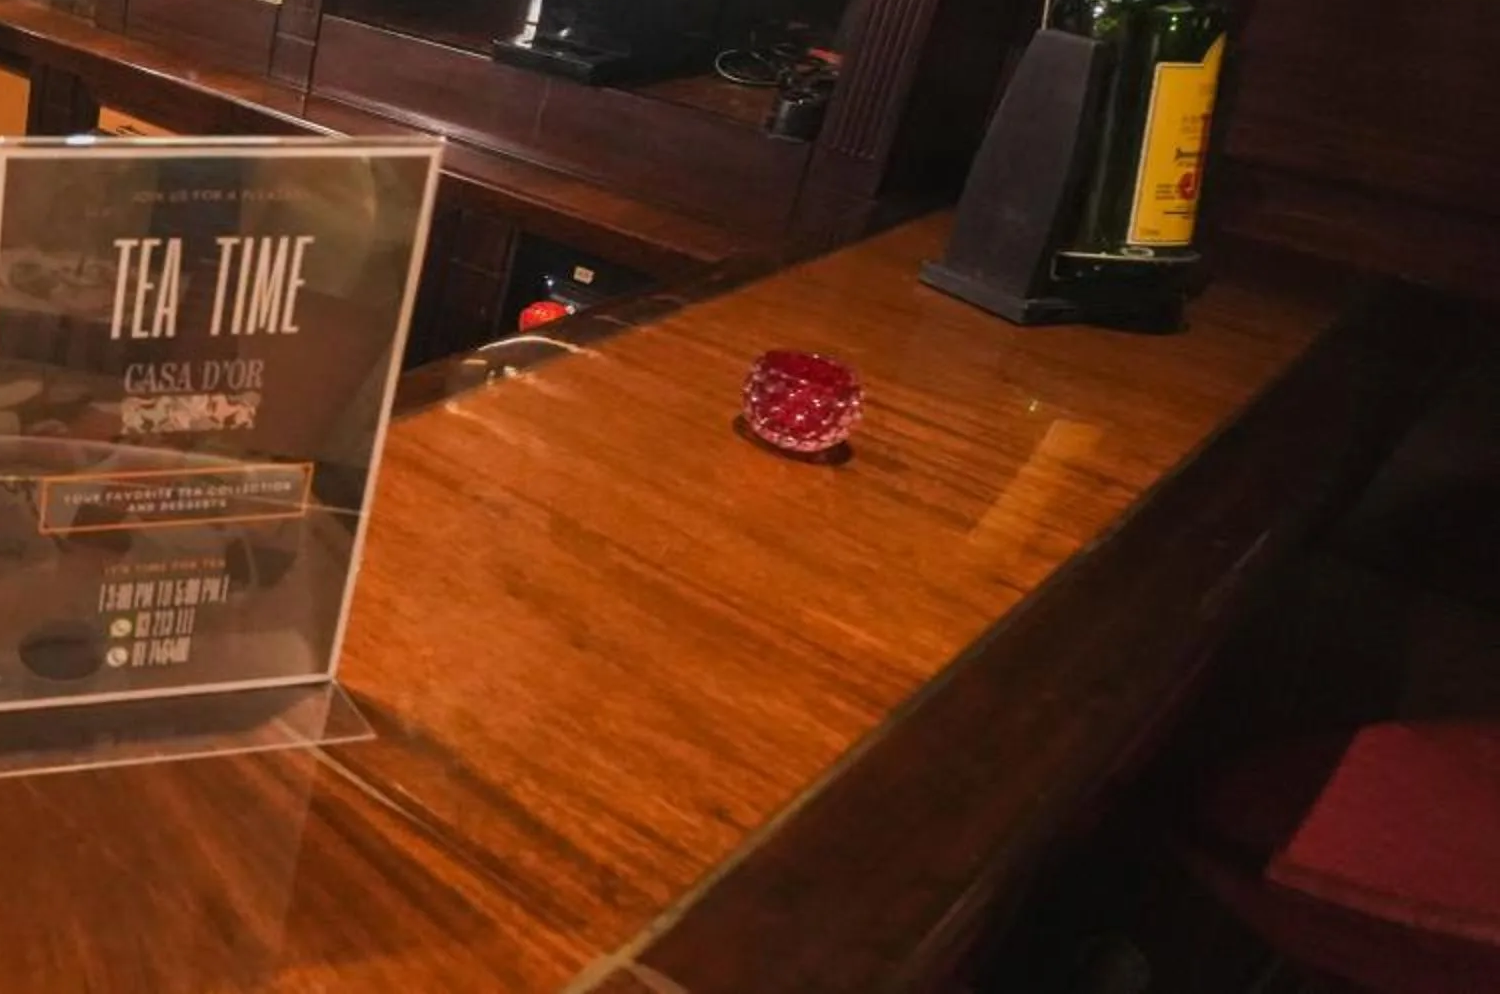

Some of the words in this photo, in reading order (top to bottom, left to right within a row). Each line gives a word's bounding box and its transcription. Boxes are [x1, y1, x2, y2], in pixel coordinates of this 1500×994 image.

[109, 237, 184, 340] TEA
[209, 235, 315, 337] TIME
[123, 362, 194, 394] CASA
[202, 358, 265, 390] D'OR
